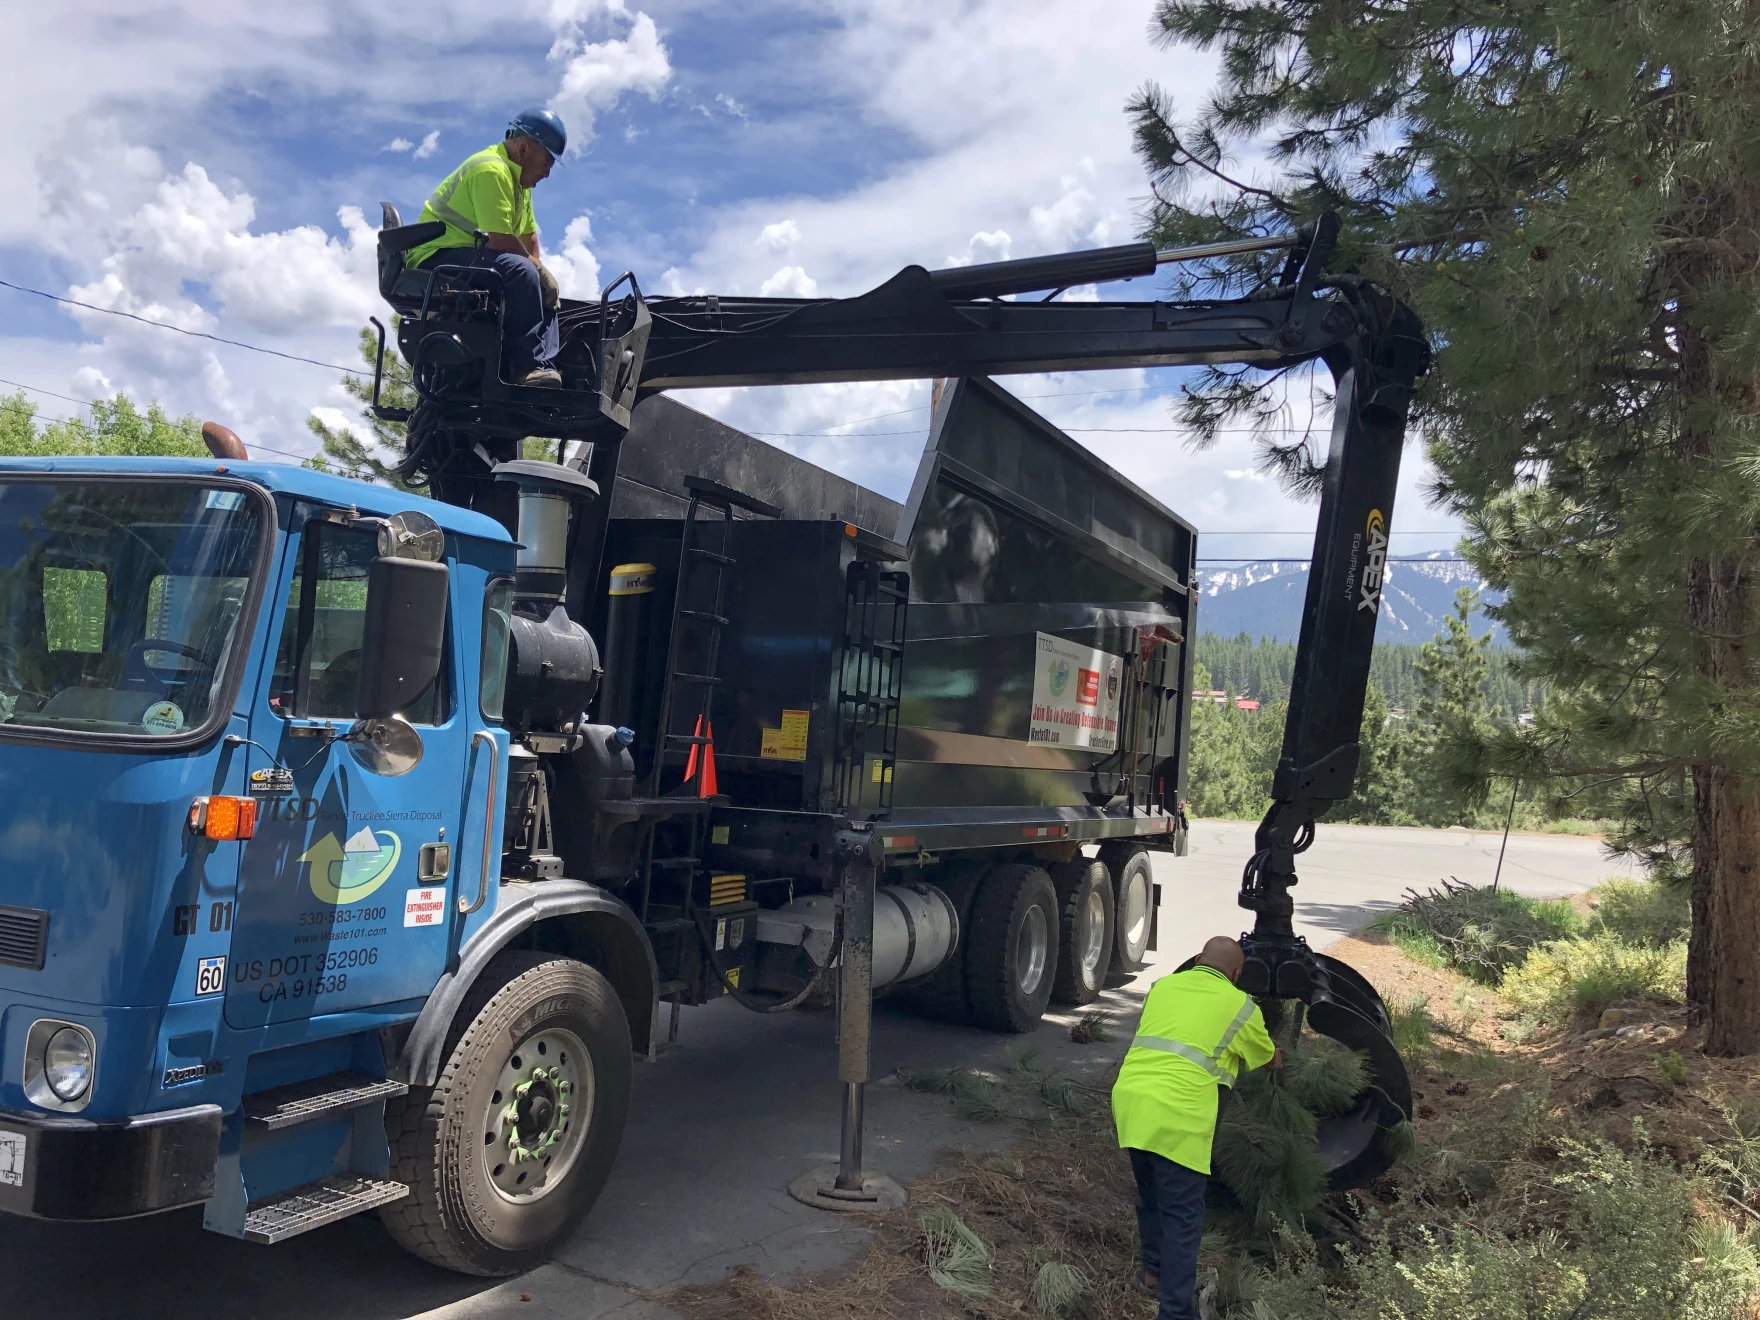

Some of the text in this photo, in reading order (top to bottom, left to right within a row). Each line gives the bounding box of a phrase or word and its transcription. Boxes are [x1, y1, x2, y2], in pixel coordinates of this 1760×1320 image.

[1344, 533, 1361, 601] EQUIPMENT
[1358, 525, 1387, 614] APEX
[1038, 637, 1053, 653] TTSD
[1032, 704, 1045, 721] Join
[1046, 705, 1053, 722] Us
[1053, 706, 1060, 723] in
[1060, 707, 1081, 729] Creating
[261, 767, 294, 779] APEX
[321, 810, 347, 821] Tahoe
[351, 810, 385, 821] Truckee
[385, 810, 409, 821] Sierra
[409, 810, 443, 822] Disposal
[420, 891, 433, 901] FIRE
[299, 907, 387, 926] 530-583-7800
[406, 901, 443, 913] EXTINGUISHER
[173, 901, 233, 936] GT 01
[415, 913, 433, 924] INSIDE
[294, 927, 387, 944] www.Waste101.com
[234, 947, 379, 983] US DOT 352906
[199, 966, 222, 992] 60
[259, 974, 348, 1003] CA 91538
